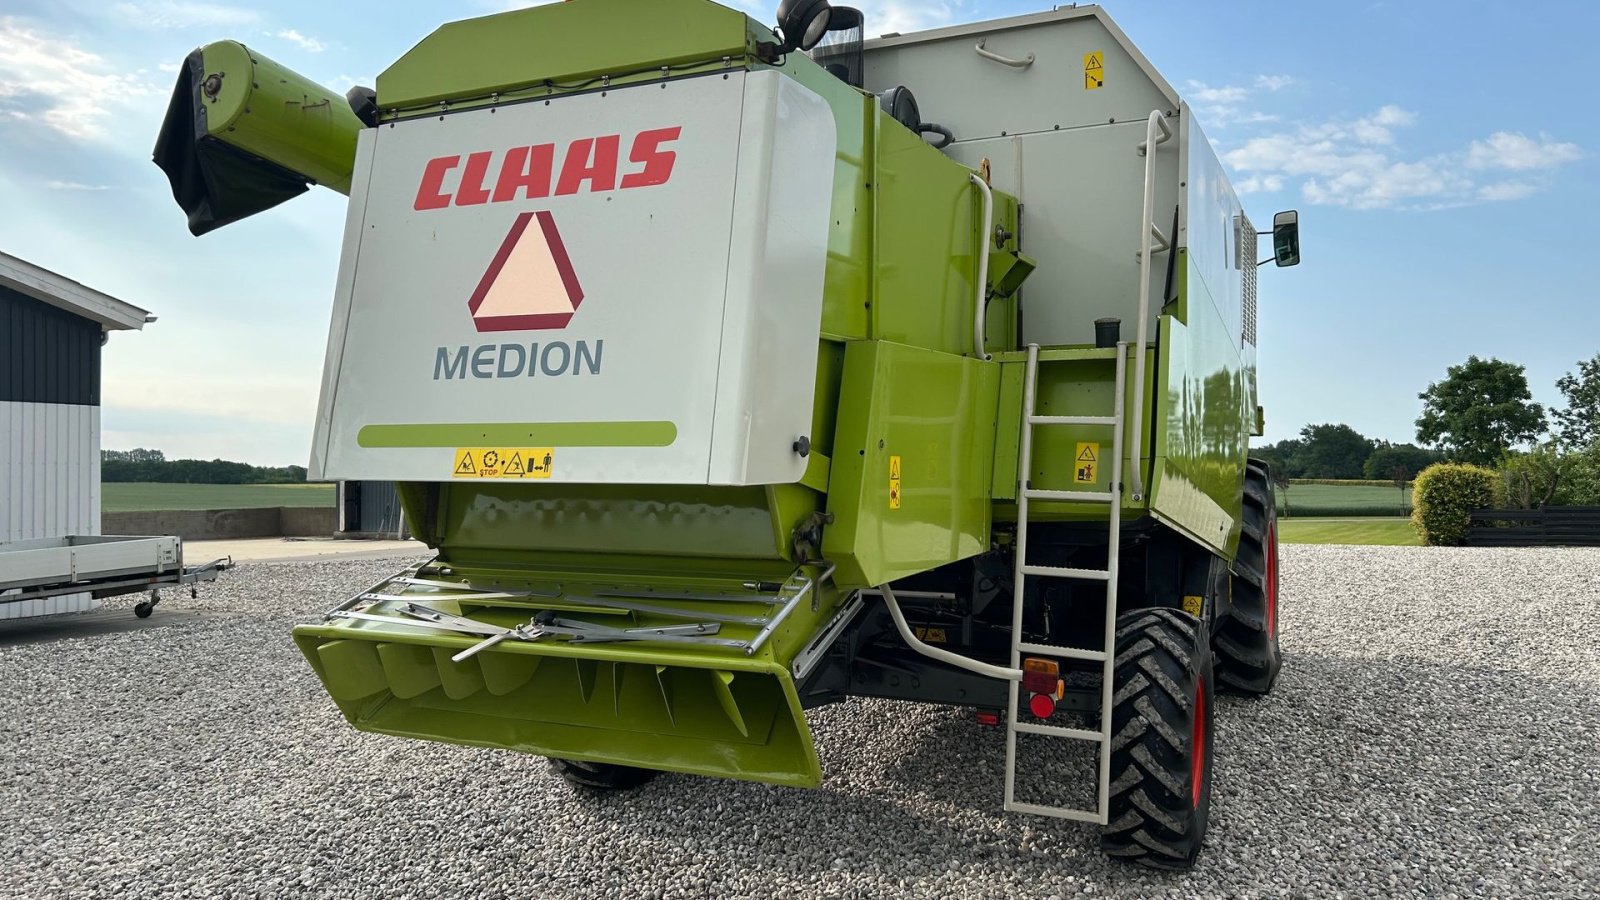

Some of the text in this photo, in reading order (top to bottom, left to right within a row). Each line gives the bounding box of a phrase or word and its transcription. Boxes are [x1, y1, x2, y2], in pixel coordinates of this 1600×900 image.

[414, 126, 682, 211] CLAAS
[433, 339, 604, 380] MEDION
[479, 468, 499, 476] STOP
